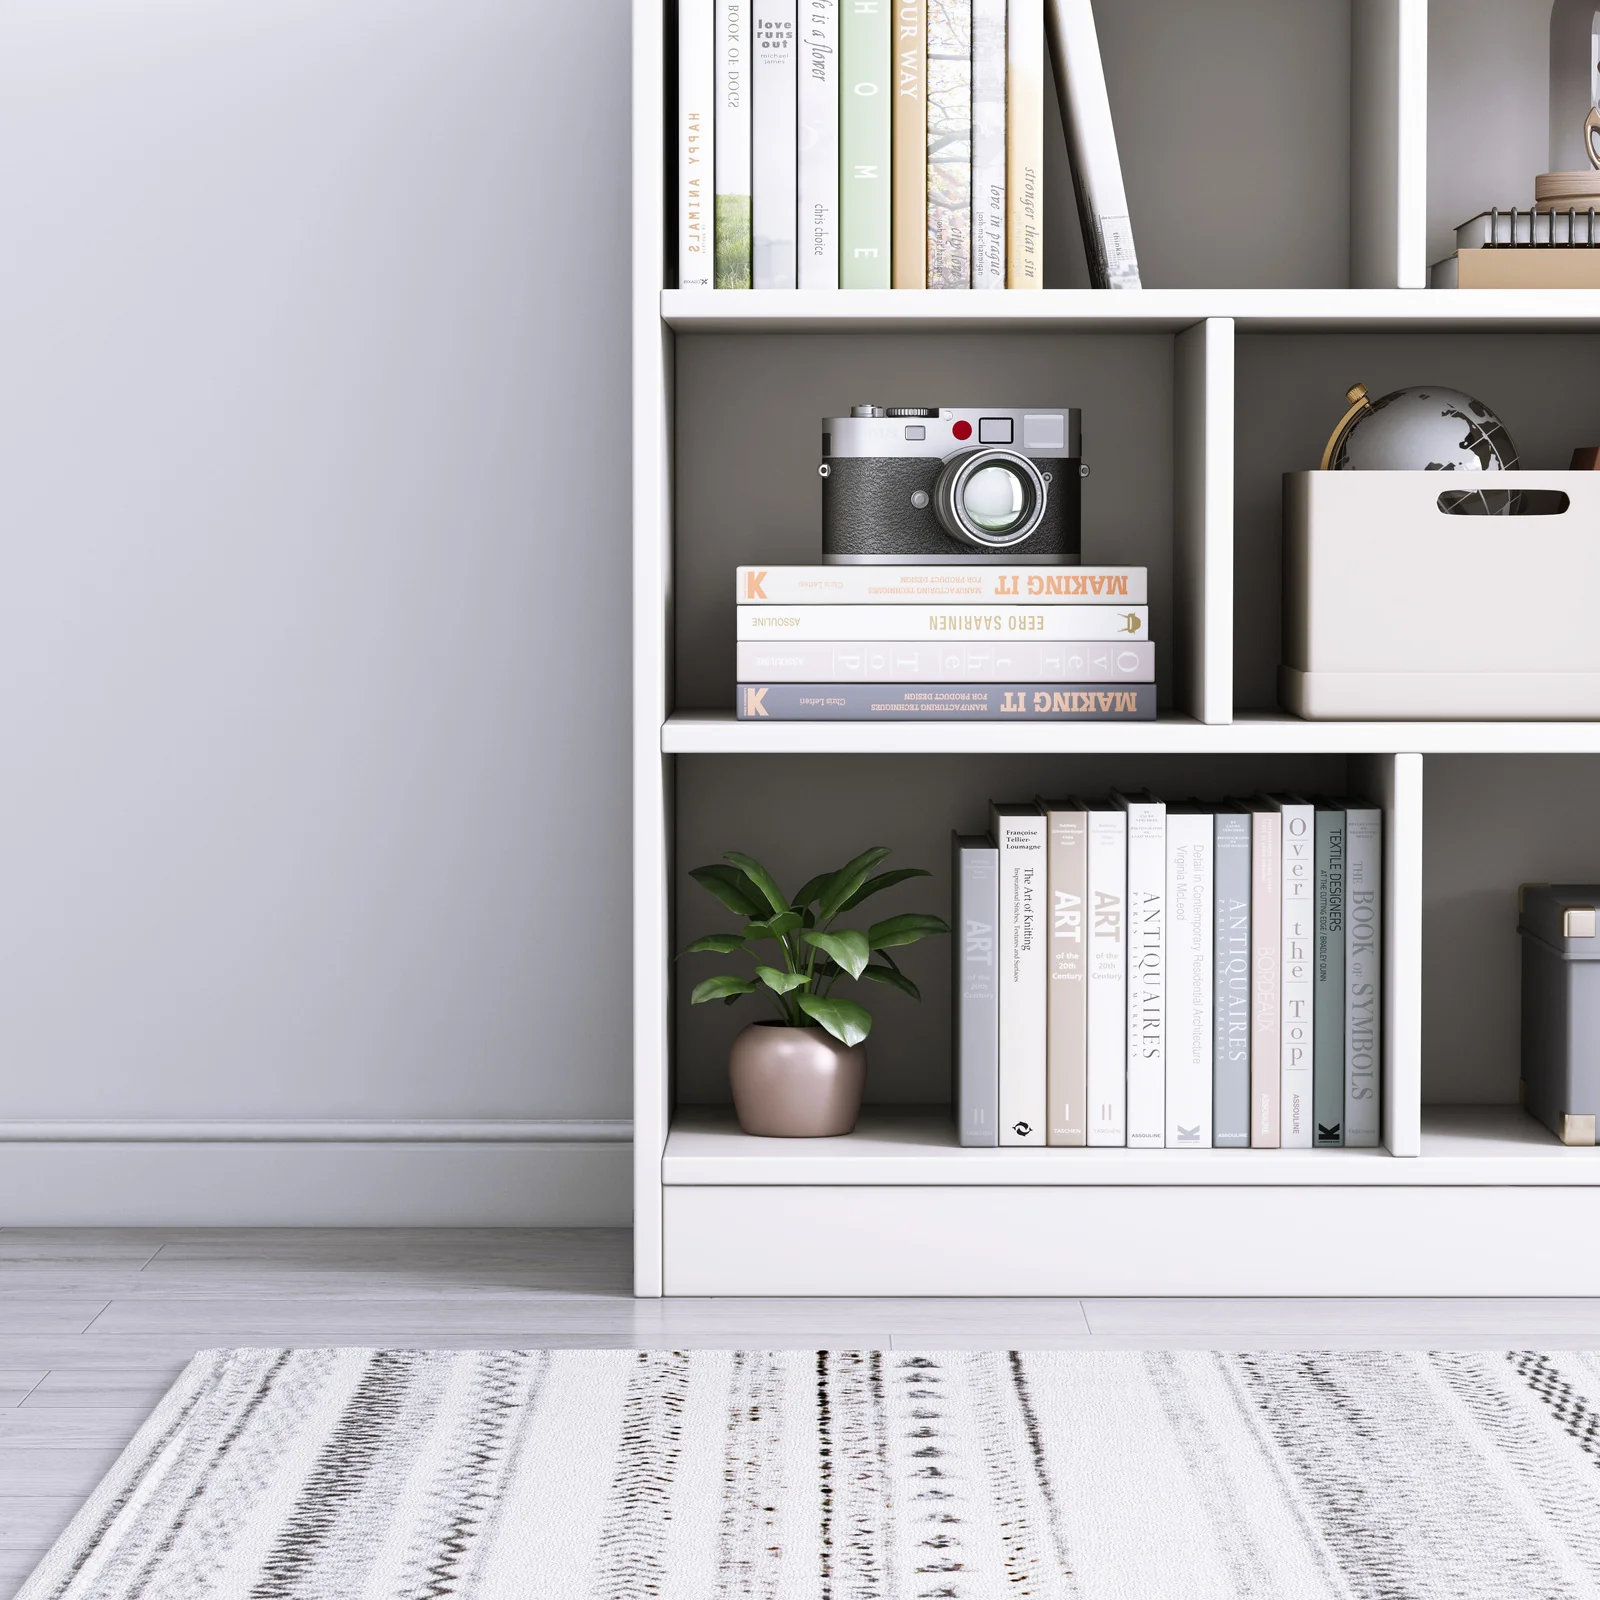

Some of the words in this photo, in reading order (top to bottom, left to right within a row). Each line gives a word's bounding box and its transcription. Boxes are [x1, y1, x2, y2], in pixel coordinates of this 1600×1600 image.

[758, 19, 792, 28] love
[812, 14, 829, 24] is
[762, 40, 788, 48] out
[812, 30, 826, 38] a
[804, 39, 833, 82] flower
[900, 48, 918, 100] WAY
[990, 184, 1004, 210] love
[1020, 166, 1036, 220] stronger
[814, 204, 828, 225] chris
[976, 212, 986, 225] josh
[990, 215, 1002, 228] in
[814, 228, 828, 256] choice
[946, 228, 965, 250] city
[1025, 224, 1040, 254] than
[1113, 232, 1122, 256] thinks
[951, 254, 968, 278] love
[985, 232, 1002, 276] prague
[1025, 258, 1036, 278] sin
[994, 575, 1020, 595] IT
[1027, 575, 1128, 595] MAKING
[752, 617, 801, 627] ASSOULINE
[928, 615, 1002, 630] SAARINEN
[1008, 615, 1044, 630] EERO
[755, 657, 804, 666] ASSOULINE
[1045, 651, 1140, 672] Over
[800, 698, 824, 706] Lefteri
[826, 698, 846, 706] Chris
[1000, 692, 1026, 712] IT
[1033, 692, 1137, 712] MAKING
[1193, 844, 1204, 872] Detail
[1289, 818, 1306, 896] Over
[1329, 829, 1342, 869] TEXTILE
[1174, 845, 1188, 880] Virginia
[1353, 861, 1363, 883] THE
[1012, 867, 1020, 901] Inspirational
[1024, 868, 1034, 884] The
[1193, 874, 1204, 883] in
[1024, 887, 1034, 901] Art
[1177, 883, 1187, 921] McLeod
[1329, 874, 1342, 932] DESIGNERS
[1024, 903, 1034, 913] of
[1055, 890, 1081, 943] ART
[1094, 890, 1120, 942] ART
[1191, 885, 1204, 951] Contemporary
[1021, 915, 1034, 951] Knitting
[1352, 889, 1375, 957] BOOK
[967, 920, 992, 966] ART
[1290, 923, 1304, 978] the
[1052, 972, 1082, 980] Century
[1092, 972, 1122, 980] Century
[1138, 892, 1160, 1059] ANTIQUAIRES
[1193, 954, 1204, 1006] Residential
[1225, 898, 1247, 1061] ANTIQUAIRES
[1352, 962, 1363, 977] OF
[1257, 947, 1274, 1033] BORDEAUX
[1193, 1008, 1204, 1064] Architecture
[1289, 1000, 1305, 1066] Top
[1352, 983, 1374, 1100] SYMBOLS
[1261, 1093, 1269, 1135] ASSOULINE
[1292, 1094, 1300, 1134] ASSOULINE
